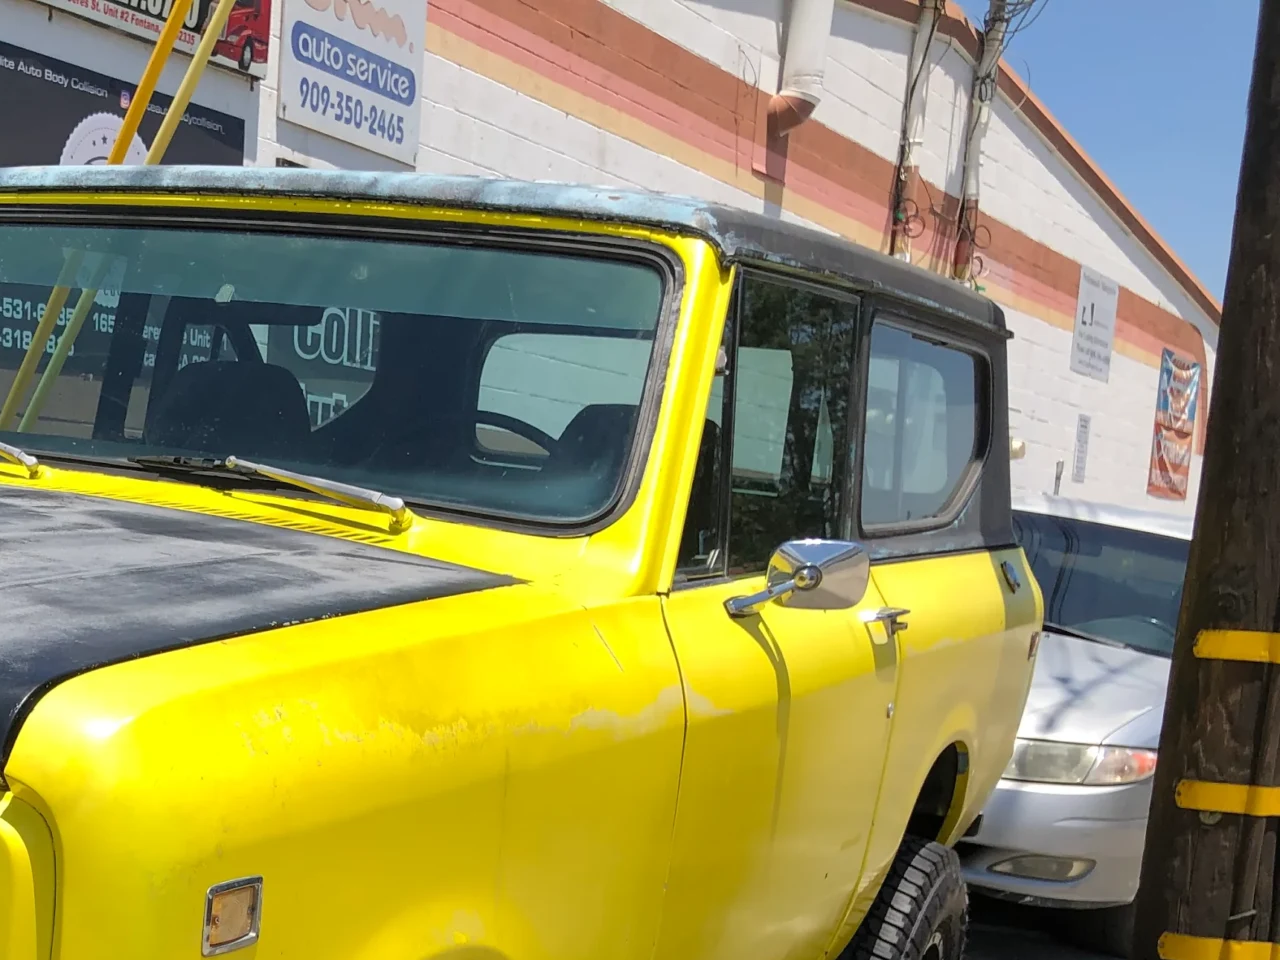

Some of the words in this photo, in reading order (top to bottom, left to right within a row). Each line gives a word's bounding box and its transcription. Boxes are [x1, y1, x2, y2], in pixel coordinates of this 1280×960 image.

[103, 3, 119, 19] Unit
[178, 30, 195, 45] 2335
[17, 61, 42, 78] Auto
[44, 68, 69, 88] Body
[70, 78, 108, 98] Collision
[298, 33, 343, 70] auto
[346, 53, 410, 98] service
[299, 76, 404, 145] 909-350-2465
[93, 312, 116, 334] 165
[190, 328, 210, 349] Unit
[293, 306, 380, 372] Coll
